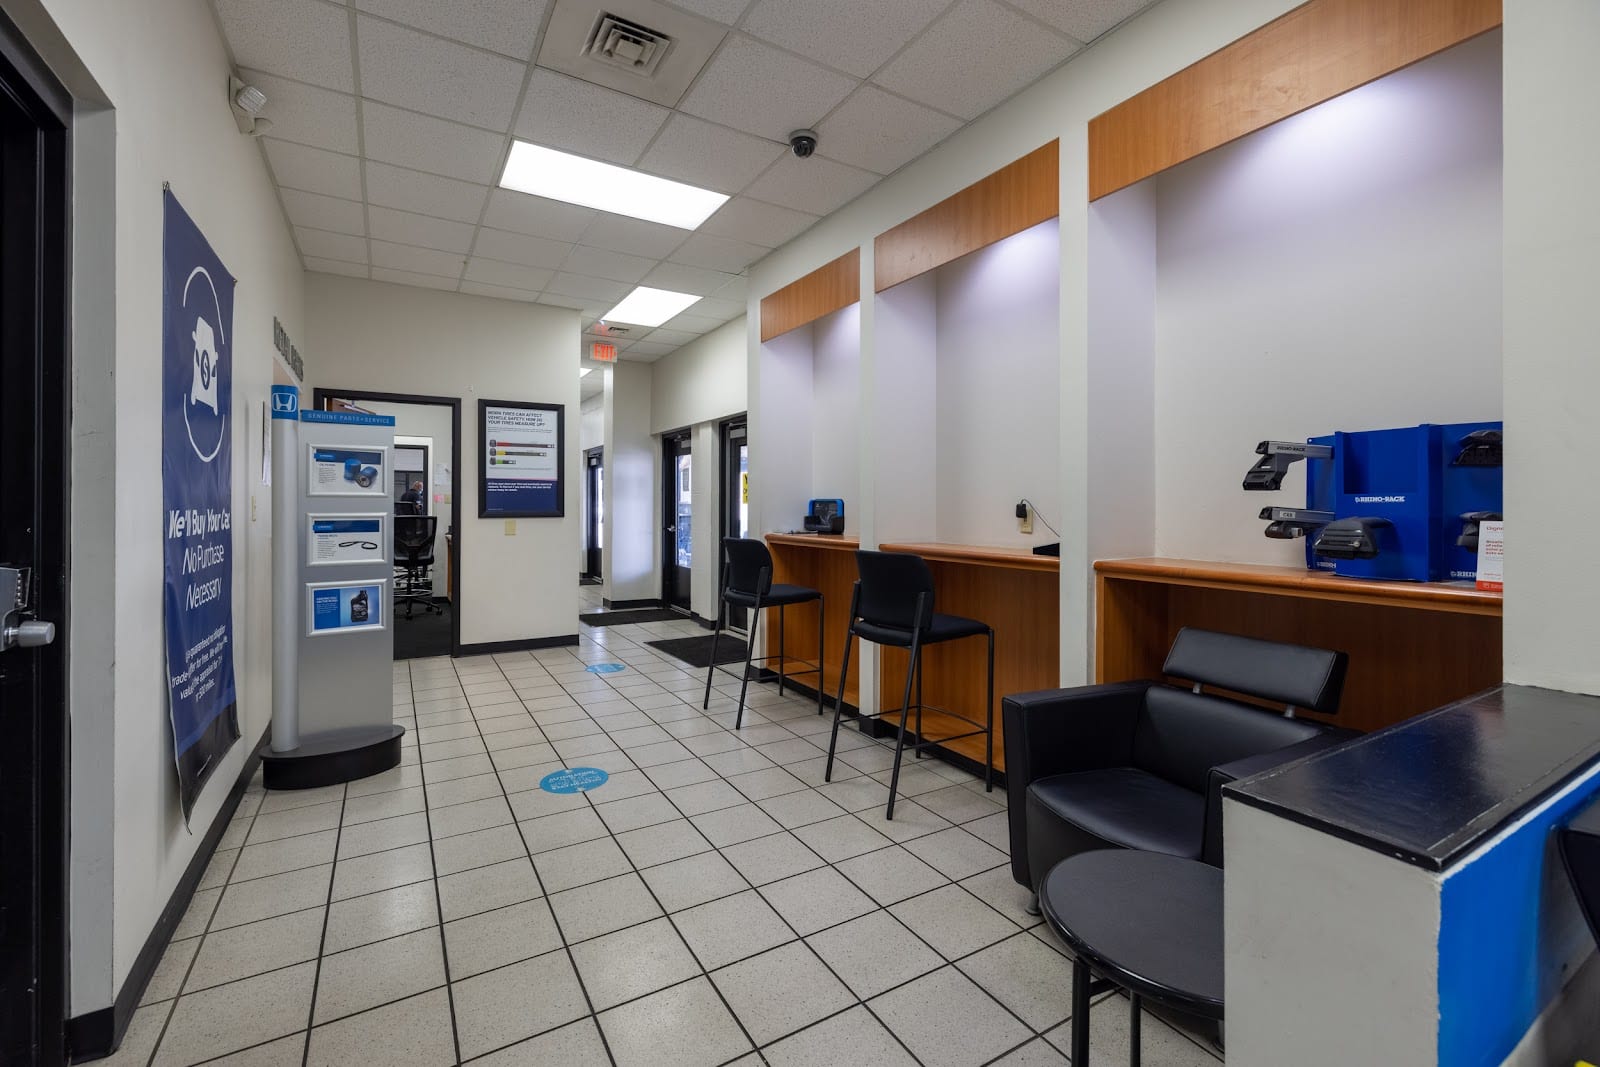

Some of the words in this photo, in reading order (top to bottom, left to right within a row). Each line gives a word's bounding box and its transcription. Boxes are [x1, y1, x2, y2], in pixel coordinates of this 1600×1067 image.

[594, 343, 613, 361] EXIT
[169, 509, 191, 539] We'll
[192, 509, 206, 540] Buy
[207, 508, 220, 533] Your
[183, 547, 196, 575] No
[197, 542, 224, 571] Purchase
[186, 577, 222, 612] Necessary
